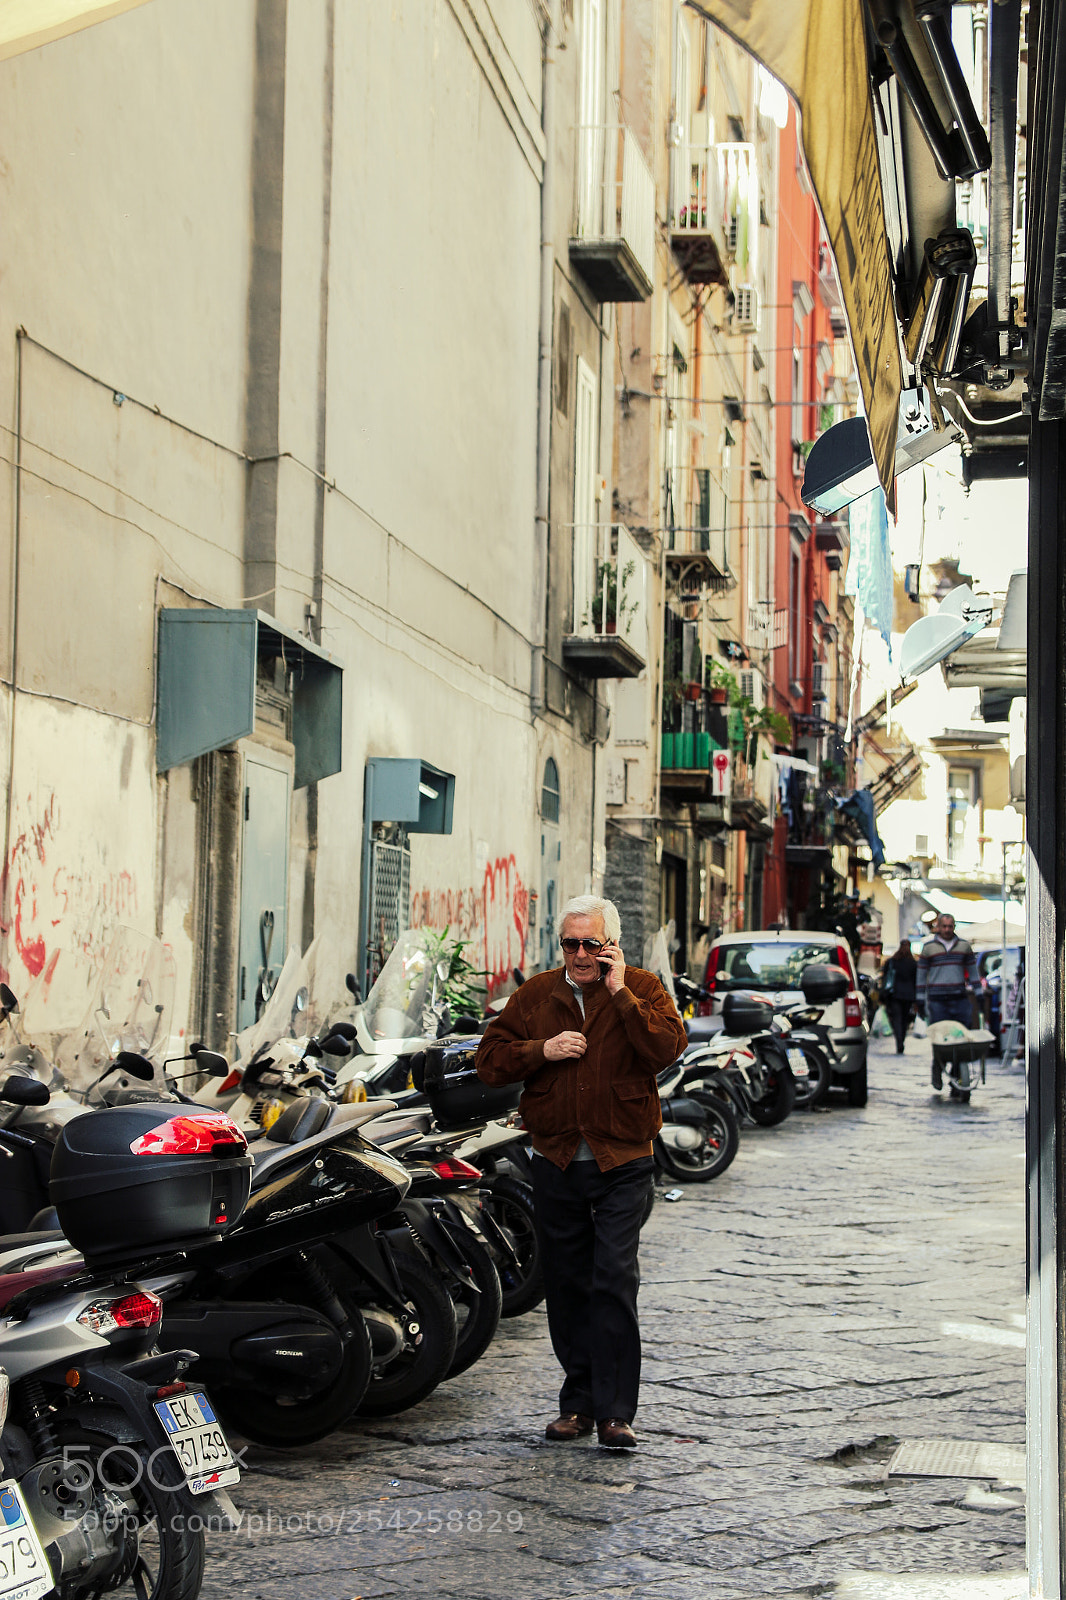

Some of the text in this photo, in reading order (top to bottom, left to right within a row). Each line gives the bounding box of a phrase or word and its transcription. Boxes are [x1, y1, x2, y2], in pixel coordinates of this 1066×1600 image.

[275, 1349, 304, 1357] HONDA
[169, 1399, 197, 1428] EK
[175, 1430, 228, 1467] 37439
